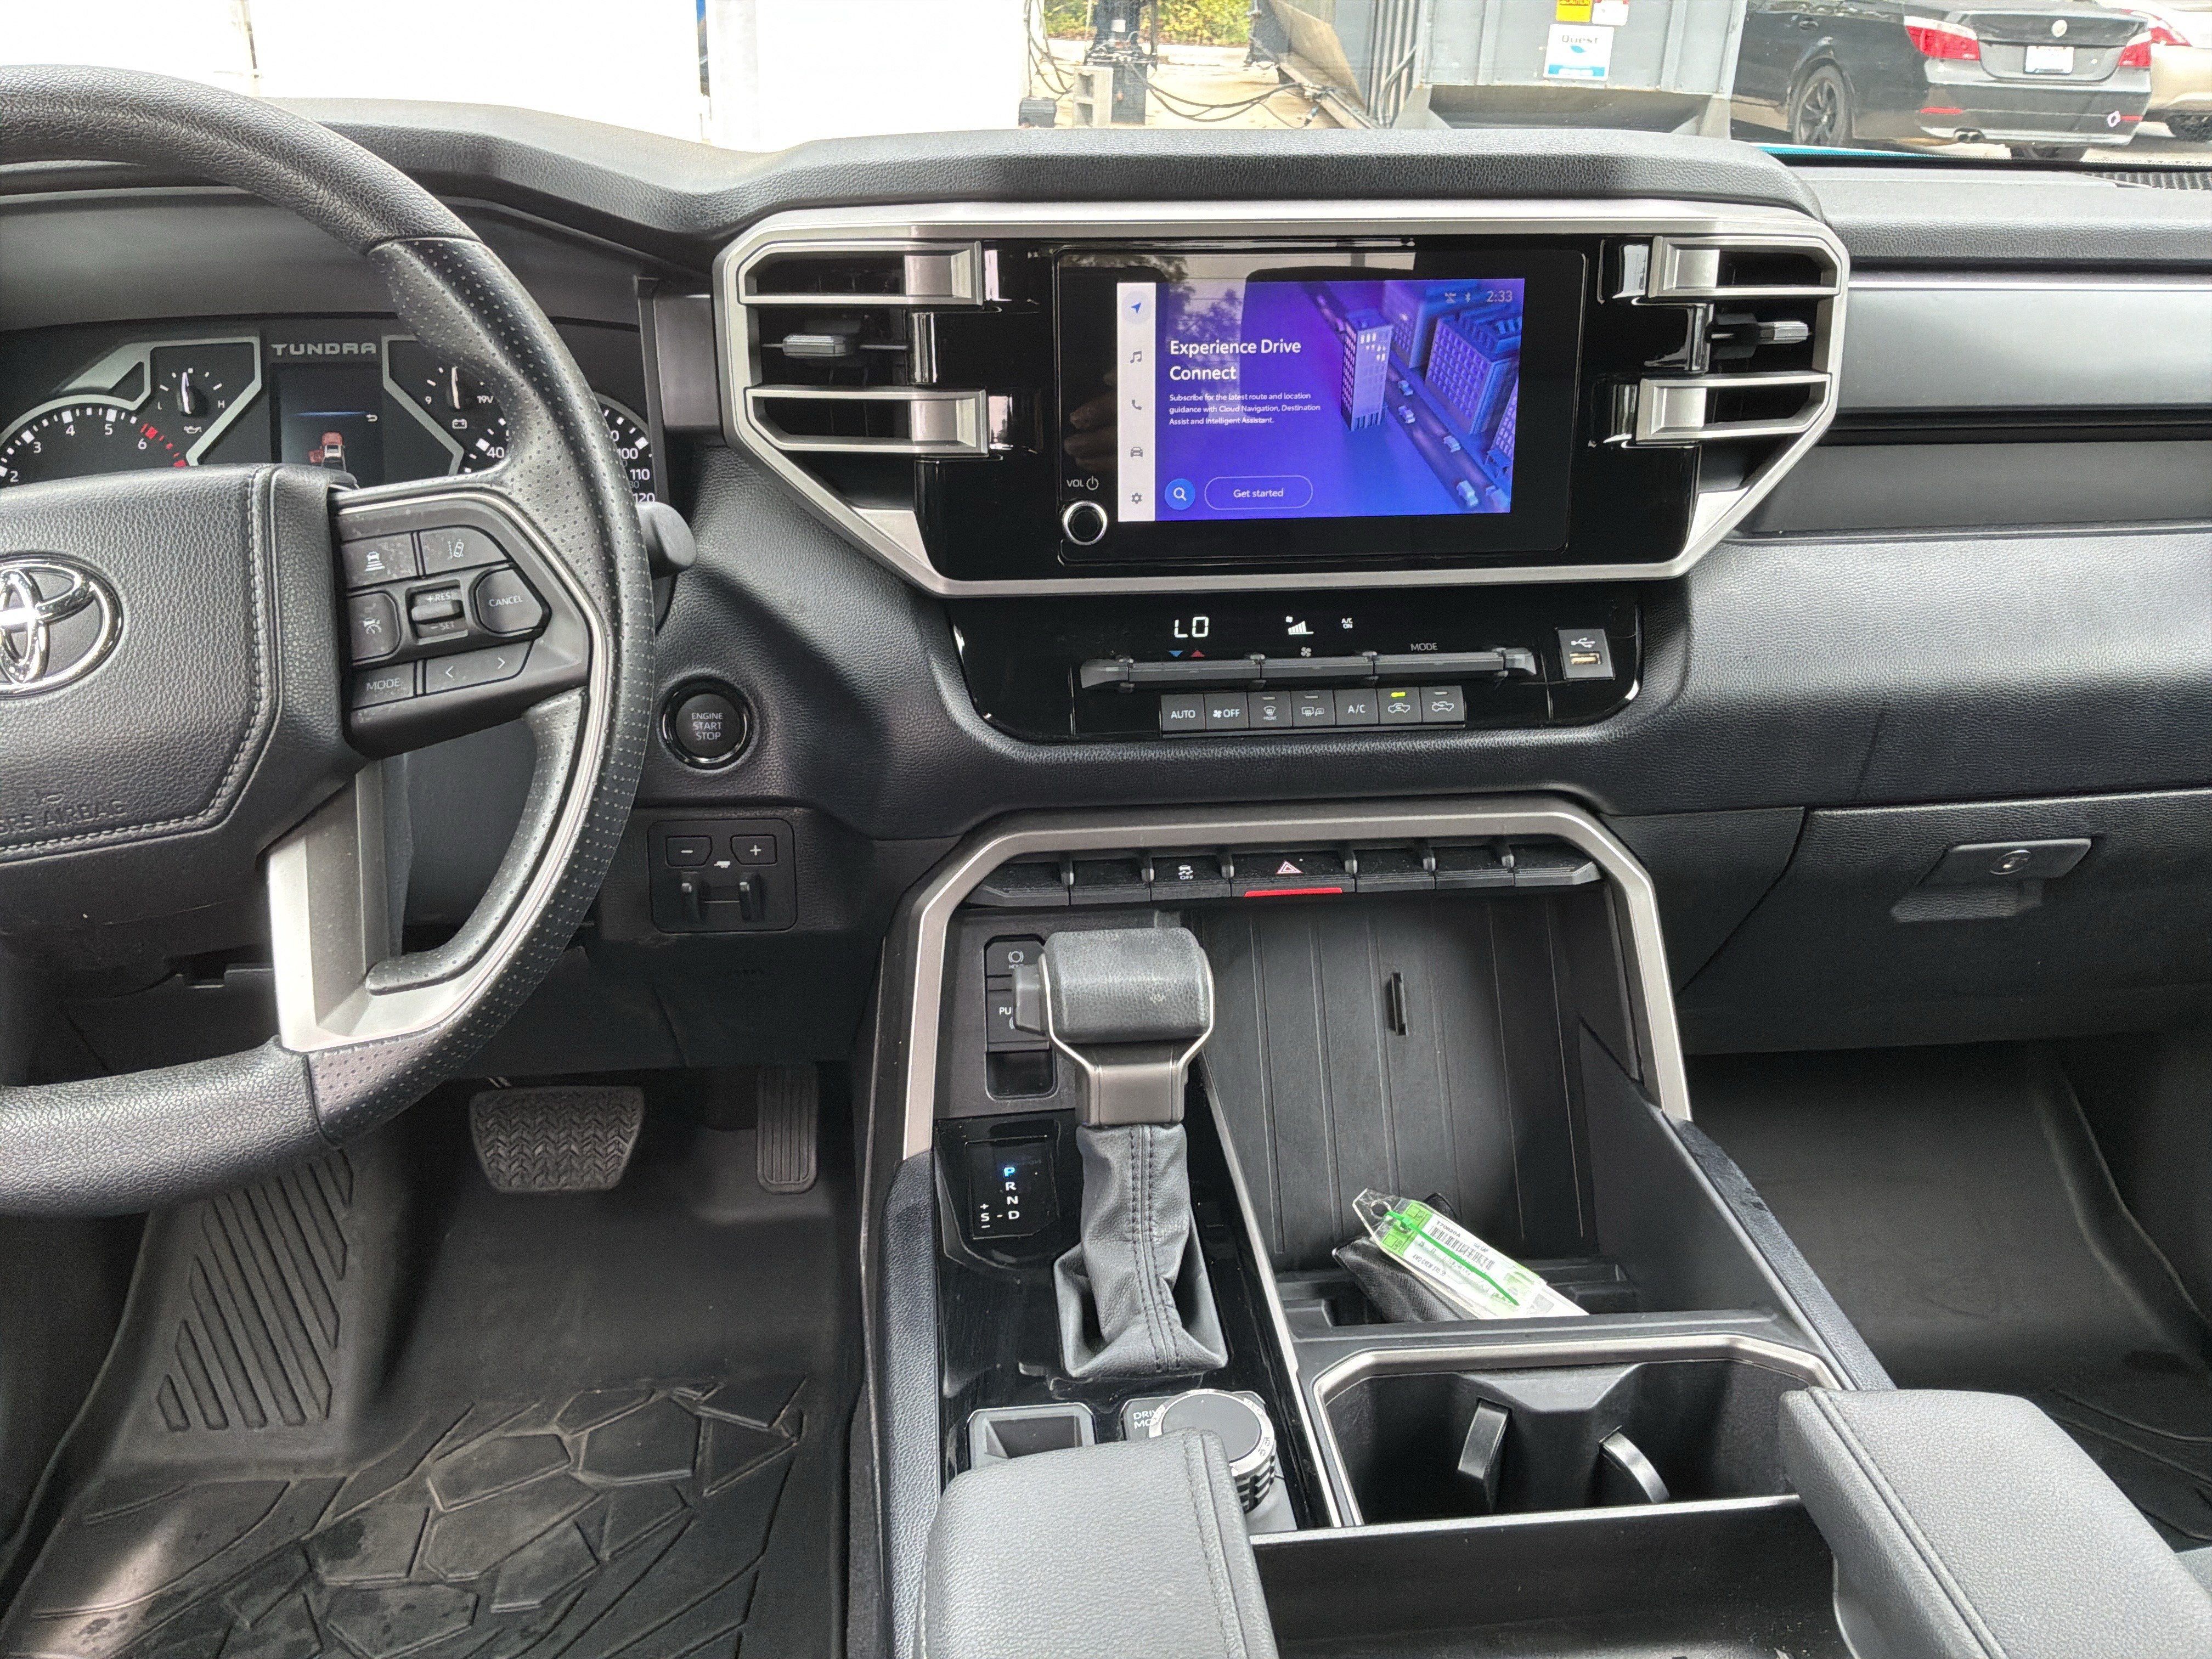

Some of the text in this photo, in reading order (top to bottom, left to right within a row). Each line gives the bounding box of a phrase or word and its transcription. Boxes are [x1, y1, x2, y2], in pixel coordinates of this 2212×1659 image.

[1487, 290, 1513, 303] 2:33
[271, 342, 376, 356] TUNDRA
[1170, 338, 1301, 358] Experience Drive
[1169, 365, 1237, 381] Connect
[218, 400, 225, 409] H
[476, 395, 494, 404] 19V
[1169, 406, 1202, 415] guidance
[1218, 405, 1240, 413] Cloud
[1241, 404, 1280, 413] Navigation,
[1205, 416, 1240, 425] Intelligent
[1241, 416, 1274, 424] Assistant.
[65, 424, 75, 436] 4
[104, 424, 113, 435] 5
[33, 441, 42, 454] 3
[138, 438, 147, 450] 6
[486, 446, 505, 459] 40
[10, 470, 19, 482] 2
[629, 469, 650, 481] 110
[1066, 479, 1084, 487] VOL
[633, 492, 656, 504] 120
[1233, 487, 1284, 499] Get started
[488, 595, 523, 607] CANCEL
[1410, 642, 1438, 652] MODE
[365, 677, 401, 692] MODE
[1170, 709, 1196, 719] AUTO
[1223, 708, 1240, 719] OFF
[1347, 703, 1366, 714] A/C
[691, 712, 723, 720] ENGINE
[692, 721, 722, 731] START
[696, 731, 721, 741] STOP
[1003, 1166, 1015, 1178] P
[1005, 1181, 1017, 1191] R
[1007, 1195, 1019, 1205] N
[980, 1212, 990, 1222] S
[1008, 1210, 1020, 1220] D
